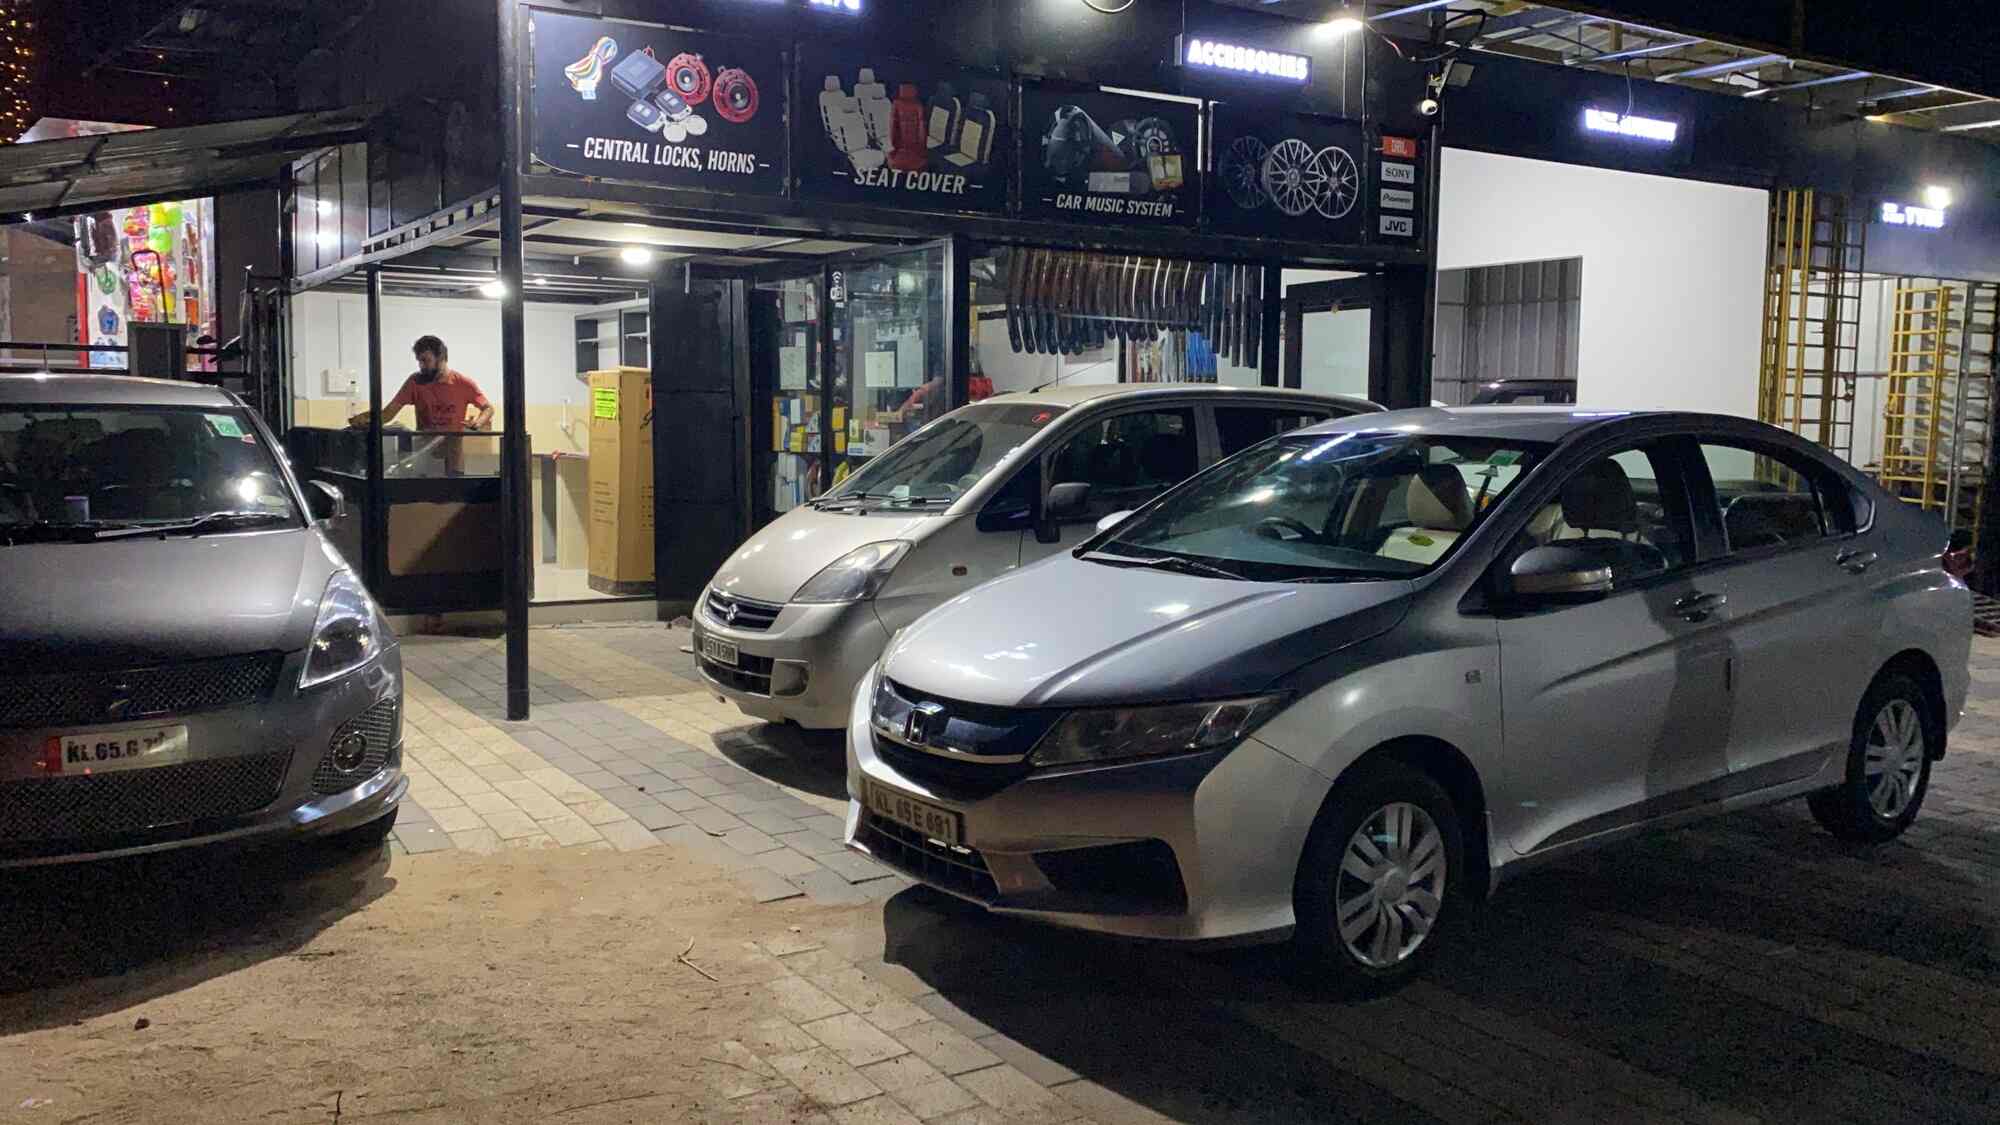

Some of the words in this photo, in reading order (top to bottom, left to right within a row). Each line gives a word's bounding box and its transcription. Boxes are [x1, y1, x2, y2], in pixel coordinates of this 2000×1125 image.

[584, 136, 649, 164] CENTRAL
[654, 144, 703, 172] LOCKS,
[708, 149, 755, 174] HORNS
[854, 166, 902, 188] SEAT
[905, 170, 965, 194] COVER
[1385, 167, 1410, 179] SONY
[1056, 194, 1082, 210] CAR
[1085, 196, 1124, 213] MUSIC
[1126, 199, 1173, 217] SYSTEM
[1385, 220, 1407, 233] JVC
